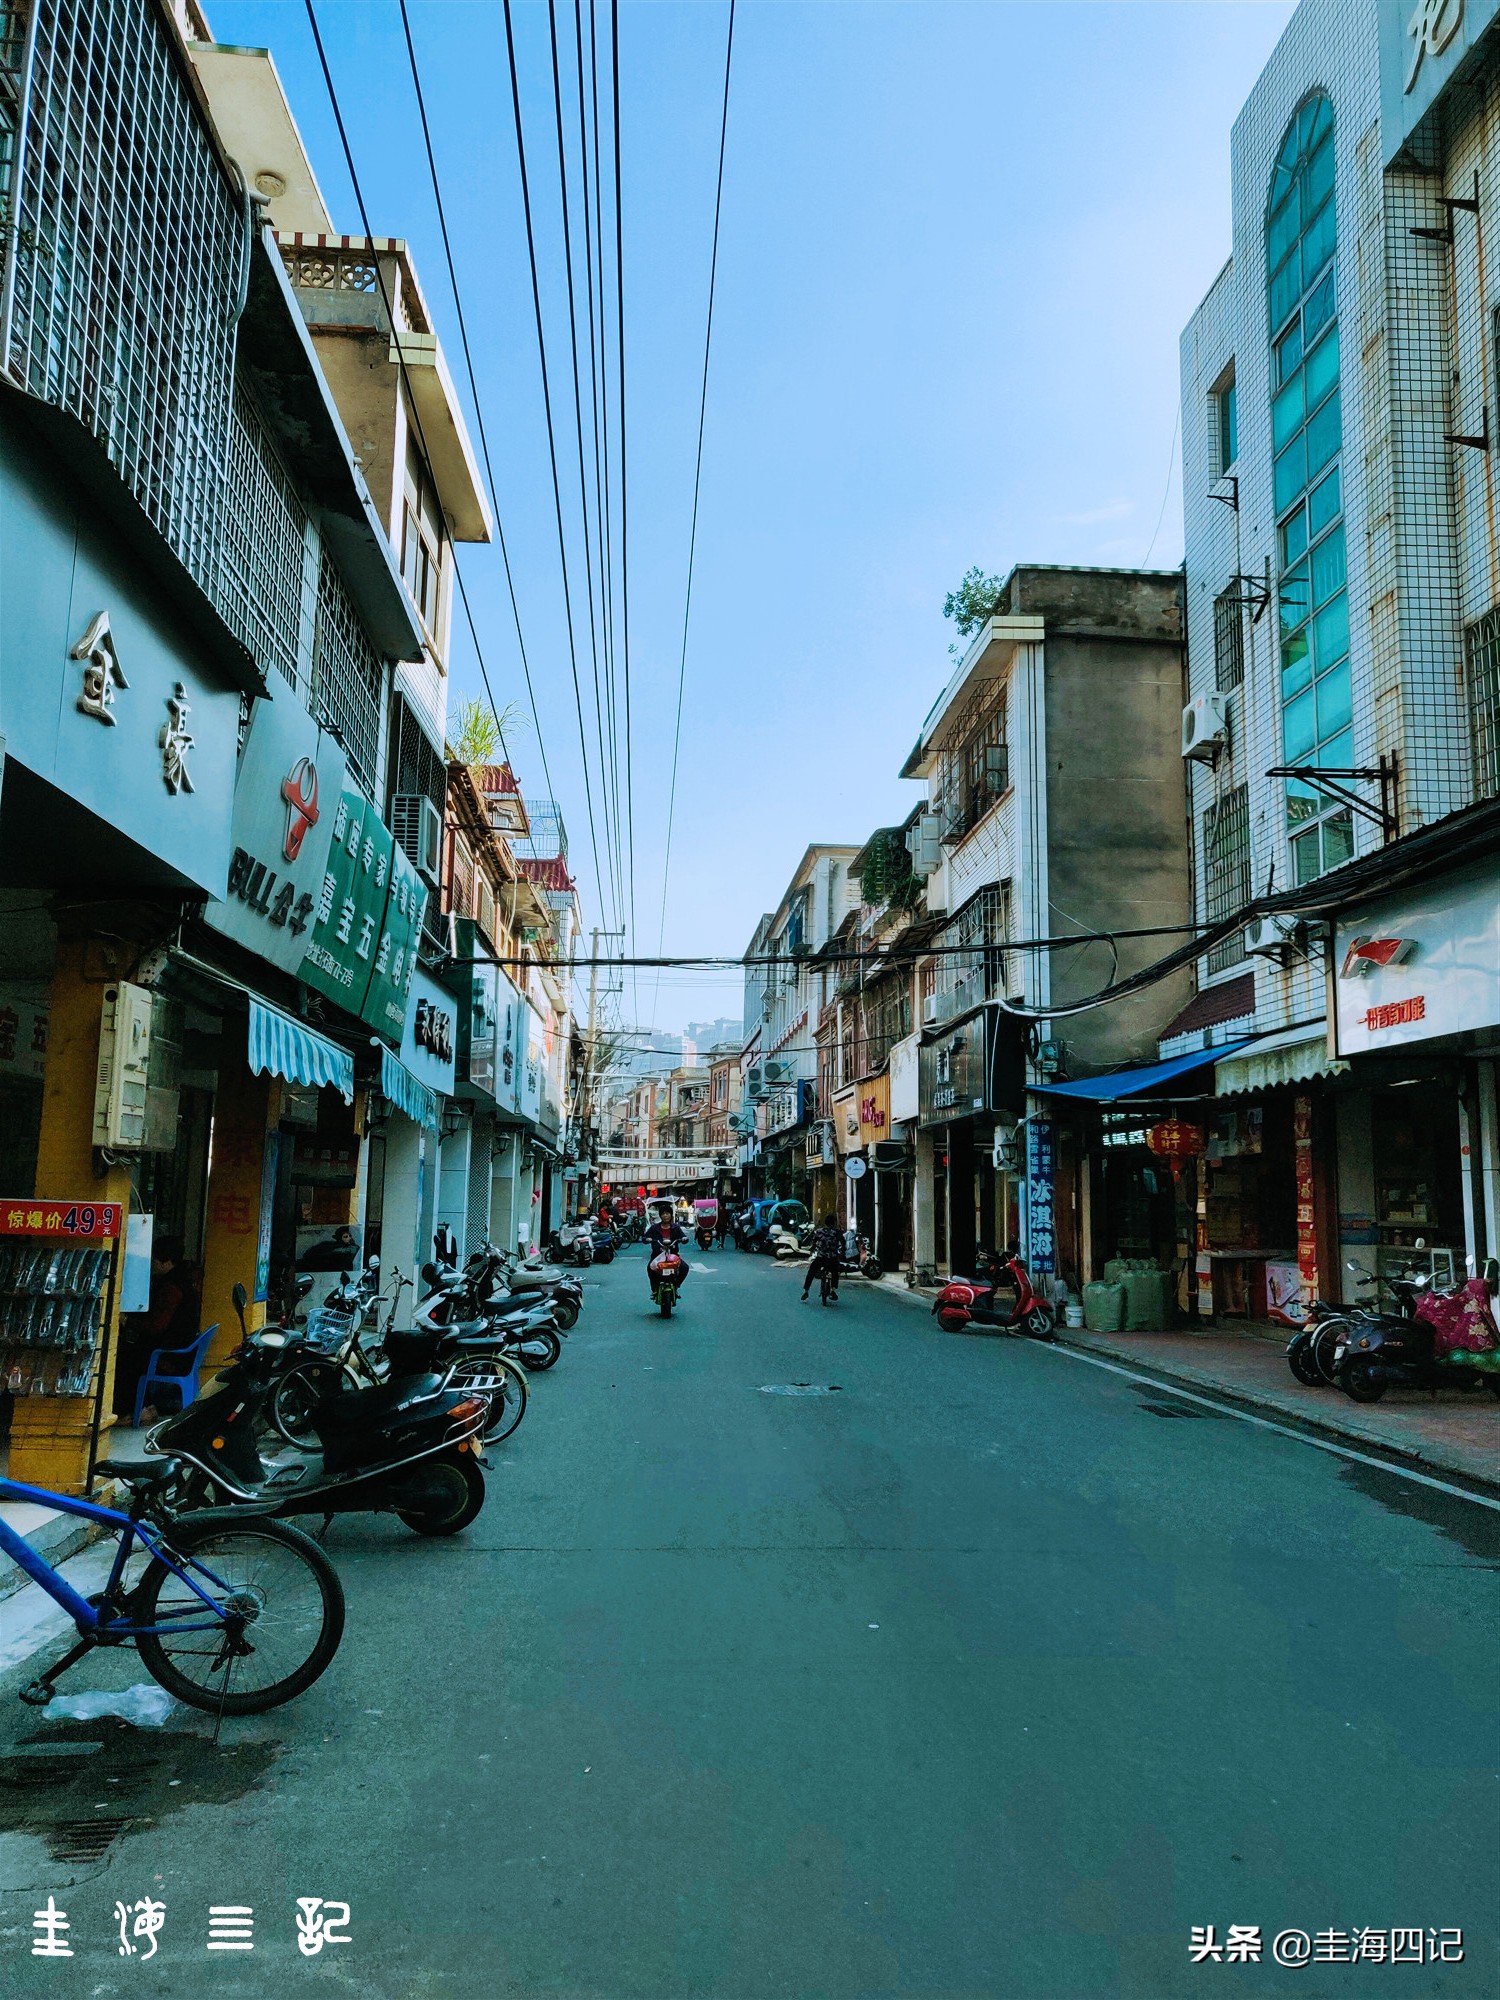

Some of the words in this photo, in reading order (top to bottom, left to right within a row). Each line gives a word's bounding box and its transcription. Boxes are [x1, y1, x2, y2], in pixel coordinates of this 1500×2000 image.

[70, 610, 196, 797] 金豪
[227, 846, 278, 916] BULL
[267, 881, 315, 938] 公牛
[7, 1210, 62, 1230] 惊爆价
[1030, 1178, 1053, 1256] 冰淇淋
